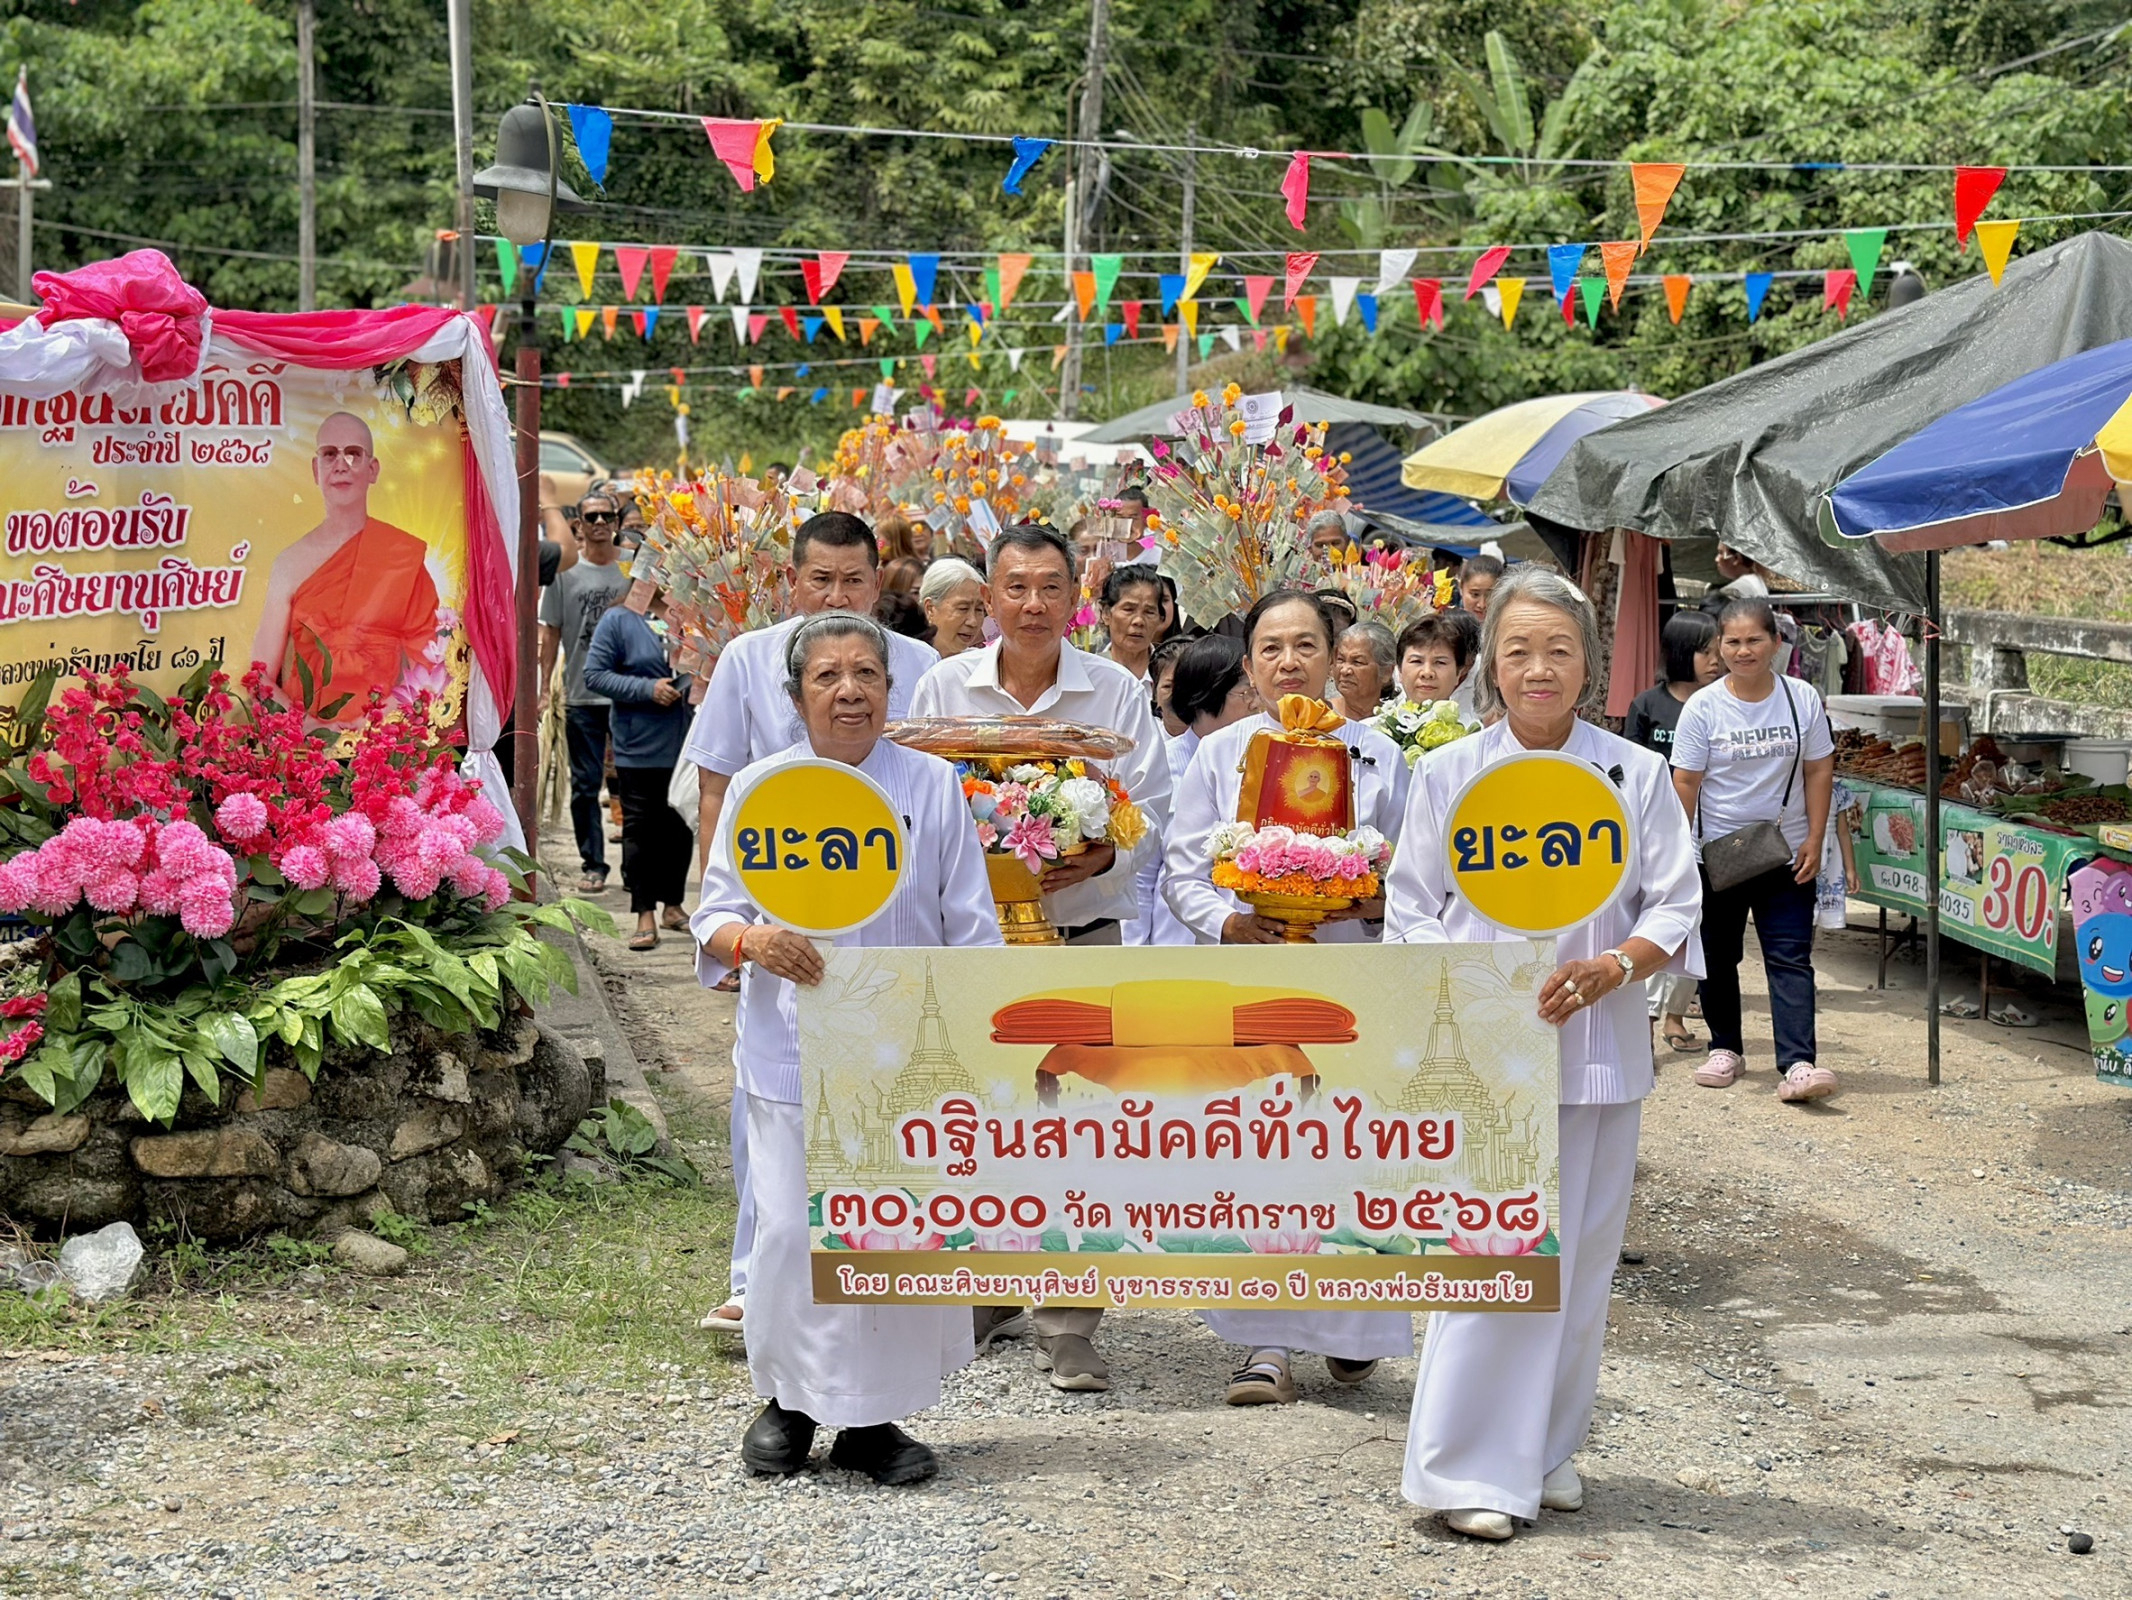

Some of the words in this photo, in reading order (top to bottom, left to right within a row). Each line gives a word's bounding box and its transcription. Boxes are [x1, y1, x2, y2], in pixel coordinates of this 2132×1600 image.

[93, 431, 180, 464] ประจำปี
[191, 438, 272, 464] ๒๕๖๘
[8, 480, 188, 552] ขอต้อนรับ
[171, 646, 200, 669] ๘๑
[209, 636, 226, 662] ปี
[1730, 726, 1792, 745] NEVER
[737, 827, 897, 871] ยะลา
[1453, 819, 1622, 873] ยะลา
[901, 1081, 1454, 1176] กฐินสามัคคีทั่วไทย
[829, 1194, 1046, 1236] ๓๐,๐๐๐
[1064, 1189, 1112, 1228] วัด
[1124, 1190, 1336, 1243] พุทธศักราช
[1353, 1189, 1539, 1231] ๒๕๖๘
[839, 1267, 887, 1292] โดย
[899, 1268, 1096, 1302] คณะศิษยานุศิษย์
[1108, 1278, 1230, 1304] บูชาธรรม
[1241, 1281, 1278, 1298] ๘๑
[1289, 1272, 1306, 1298] ปี
[1318, 1273, 1531, 1300] หลวงพ่อธัมมชโย
